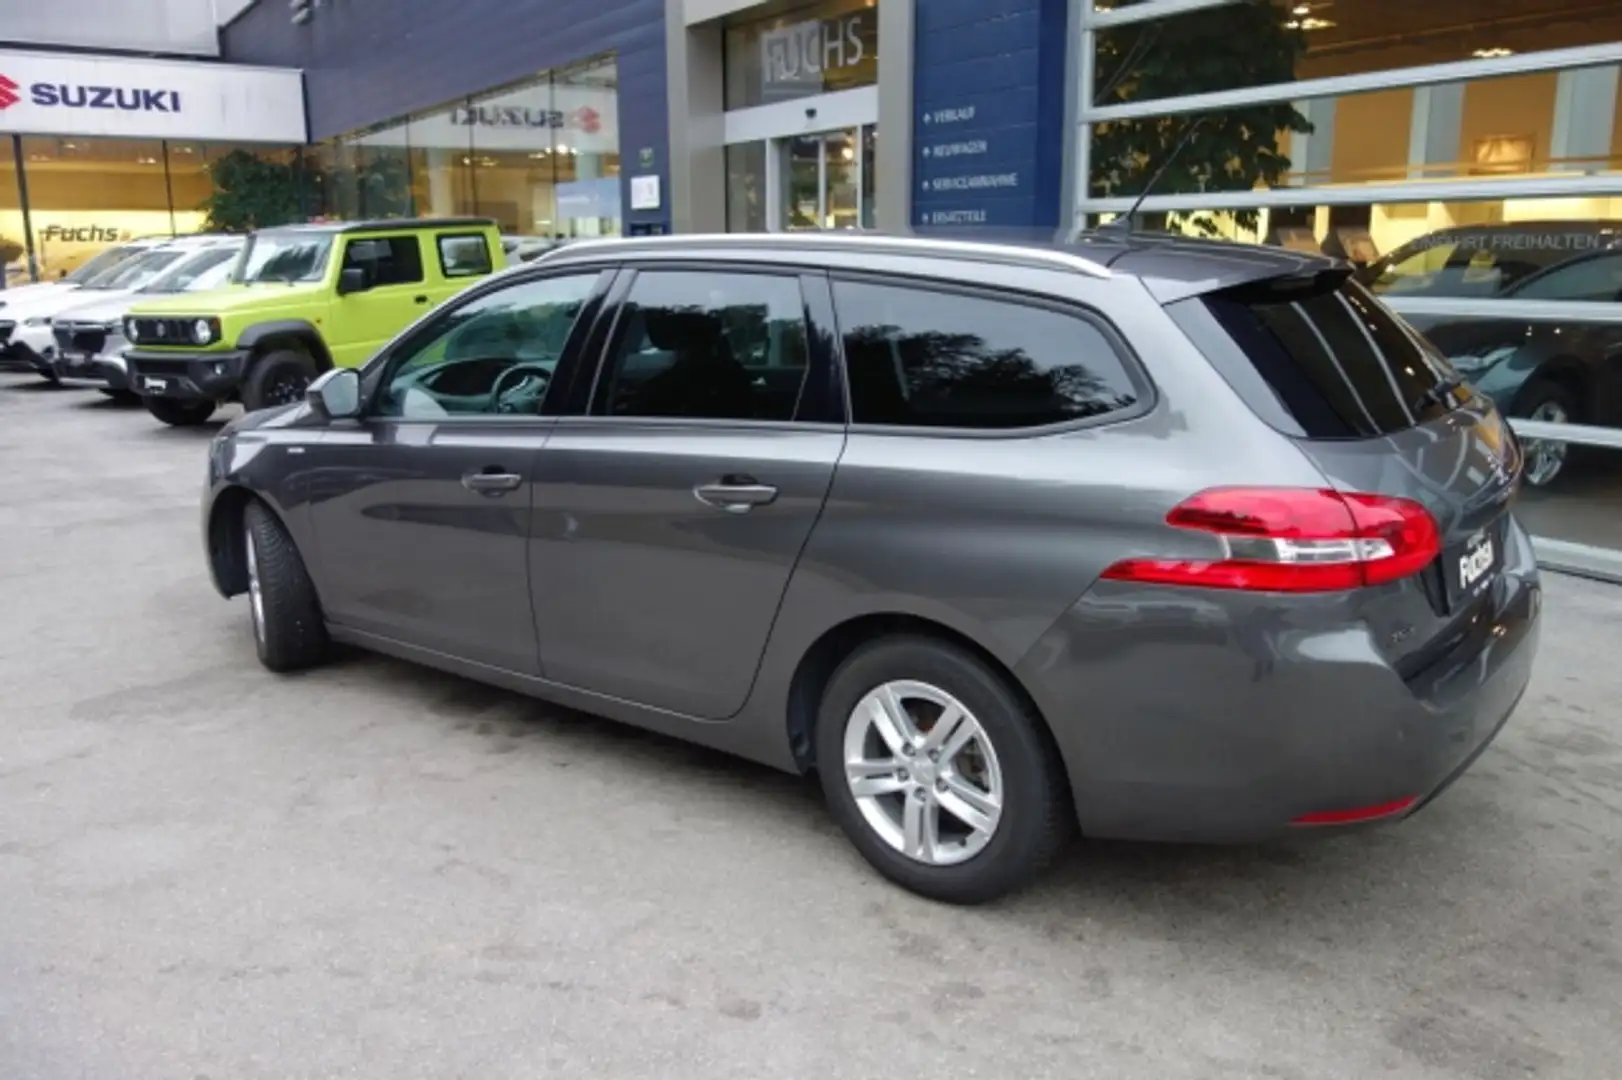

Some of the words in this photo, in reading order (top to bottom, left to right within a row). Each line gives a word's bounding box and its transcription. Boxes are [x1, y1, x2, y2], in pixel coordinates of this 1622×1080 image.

[762, 17, 863, 82] FUCHS
[30, 82, 181, 113] SUZUKI
[1491, 233, 1600, 250] FREIHALTEN
